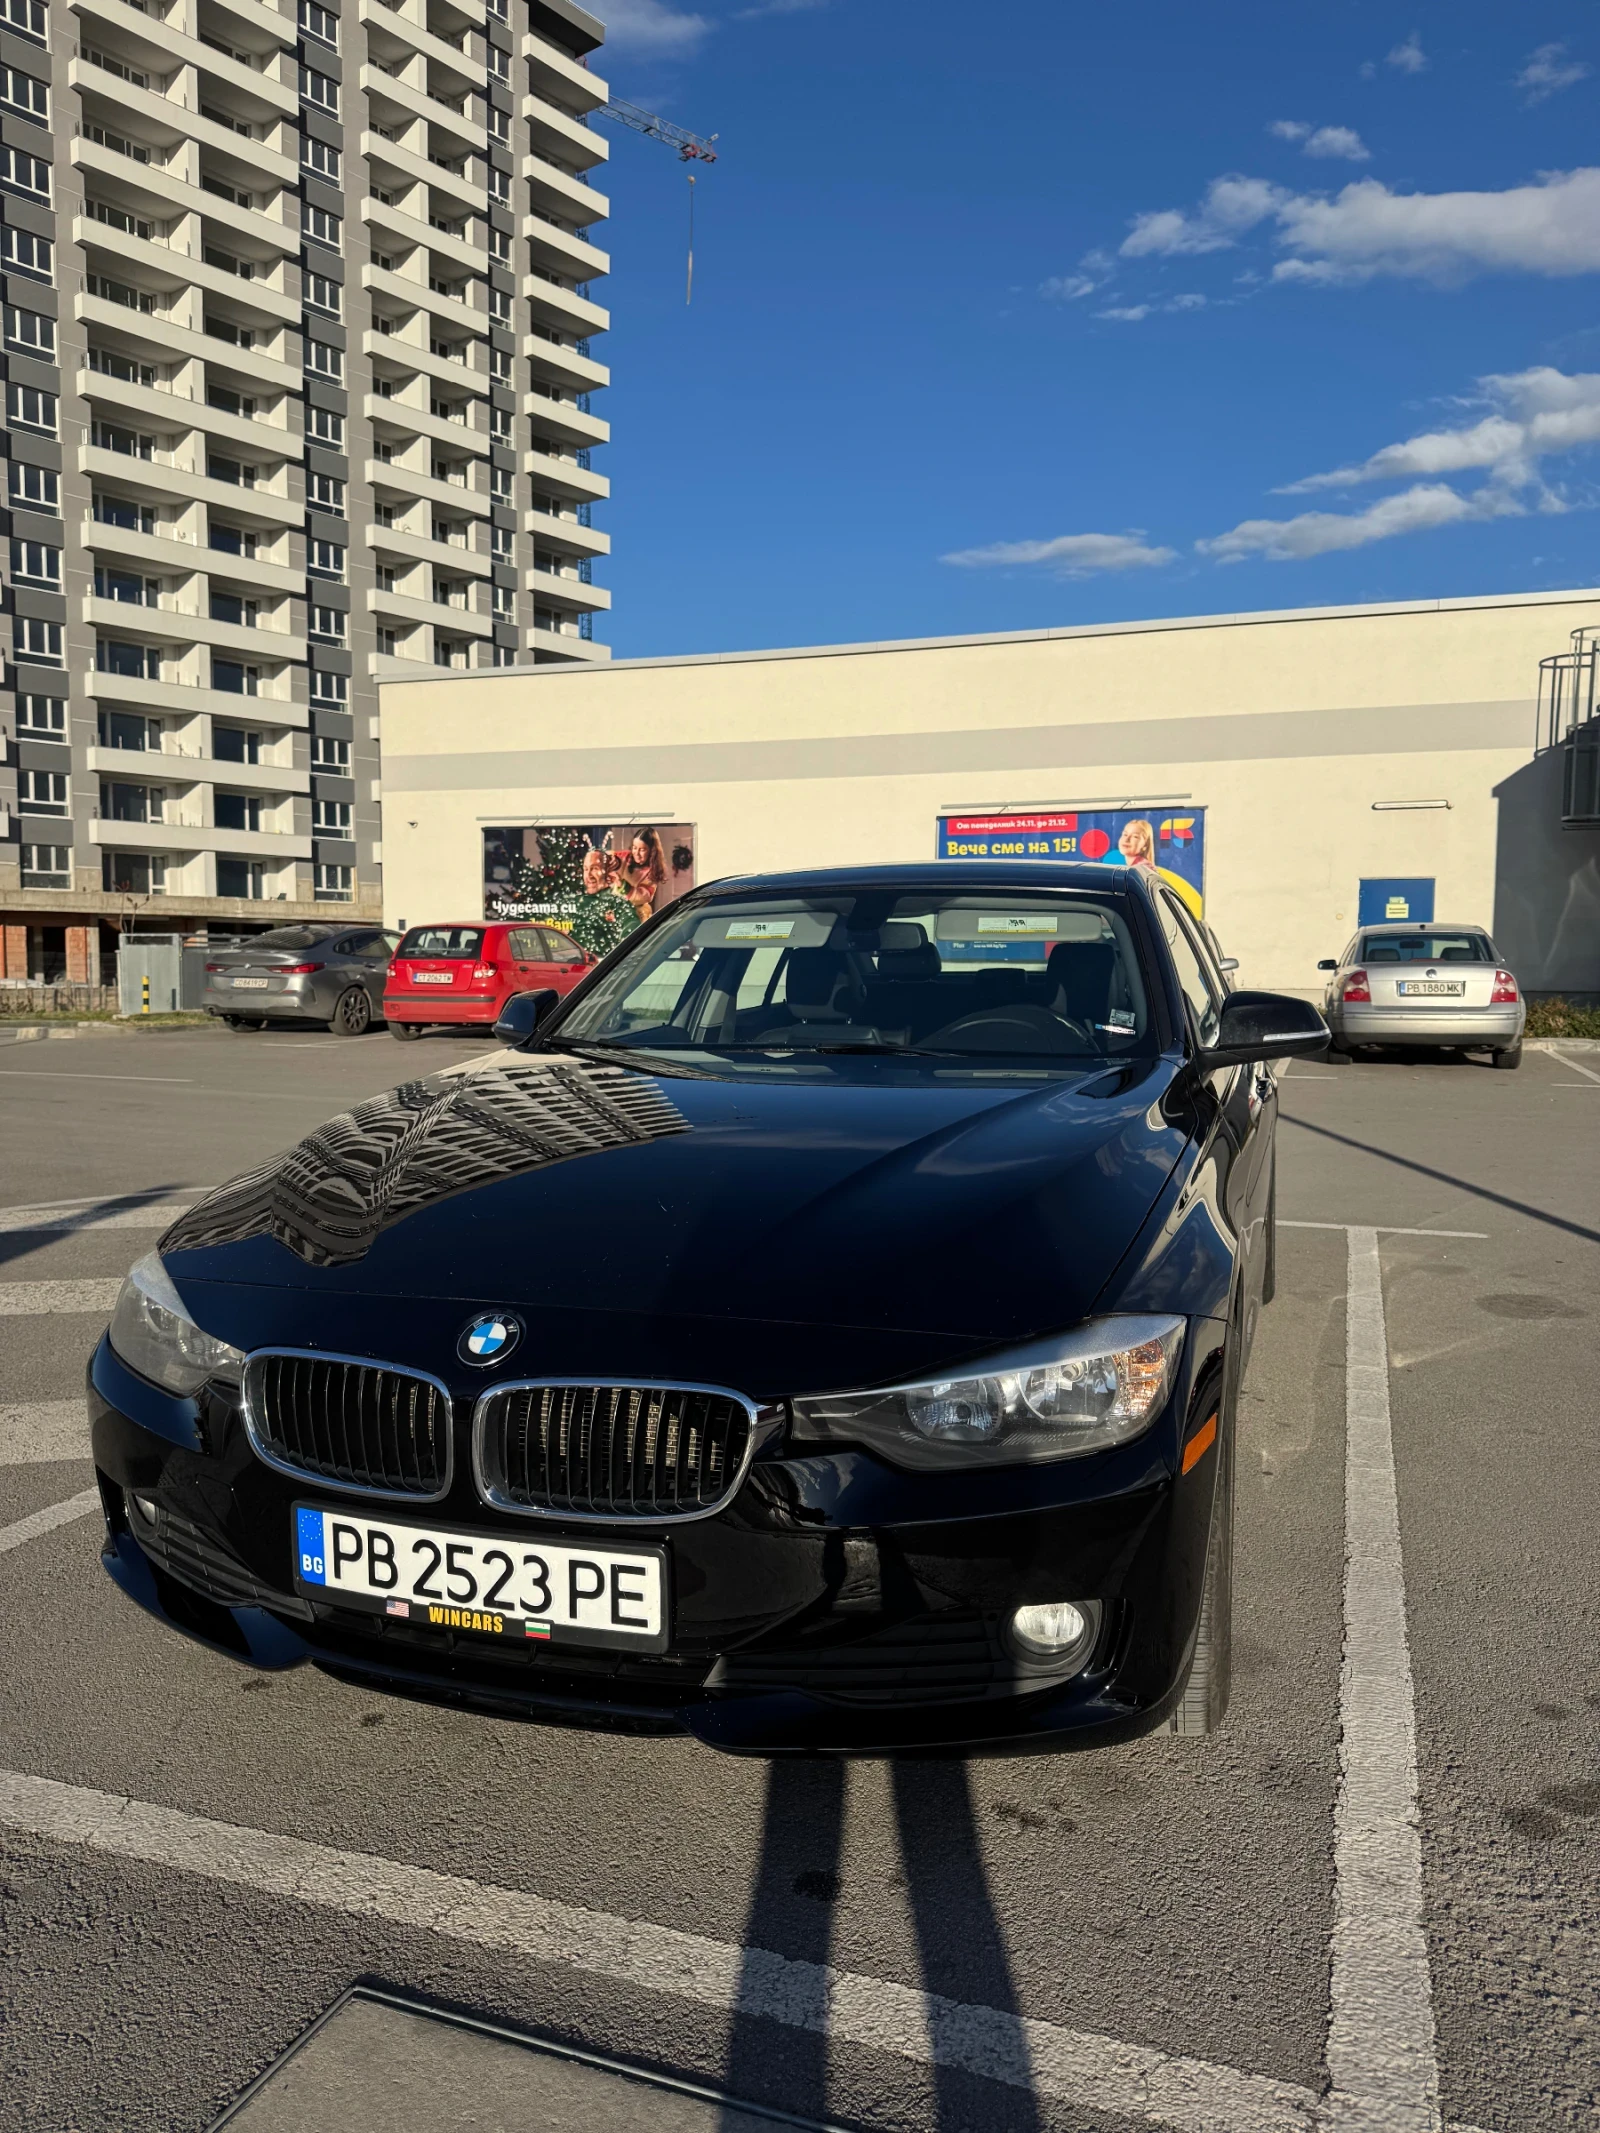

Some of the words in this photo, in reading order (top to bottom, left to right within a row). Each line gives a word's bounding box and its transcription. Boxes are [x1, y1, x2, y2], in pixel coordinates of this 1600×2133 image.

[970, 819, 1015, 830] понеделник
[1037, 820, 1047, 828] до
[947, 841, 988, 856] Вече
[991, 842, 1025, 855] сме
[1028, 841, 1050, 853] на
[1053, 837, 1077, 852] 15!
[492, 900, 559, 916] Чудесата
[560, 903, 577, 914] си
[1407, 983, 1420, 993] PB
[1423, 983, 1445, 993] 1880
[1446, 983, 1460, 993] MK
[302, 1554, 323, 1574] BG
[332, 1522, 398, 1590] PB
[412, 1539, 553, 1614] 2523
[568, 1559, 649, 1628] PE
[428, 1605, 504, 1633] WINCARS
